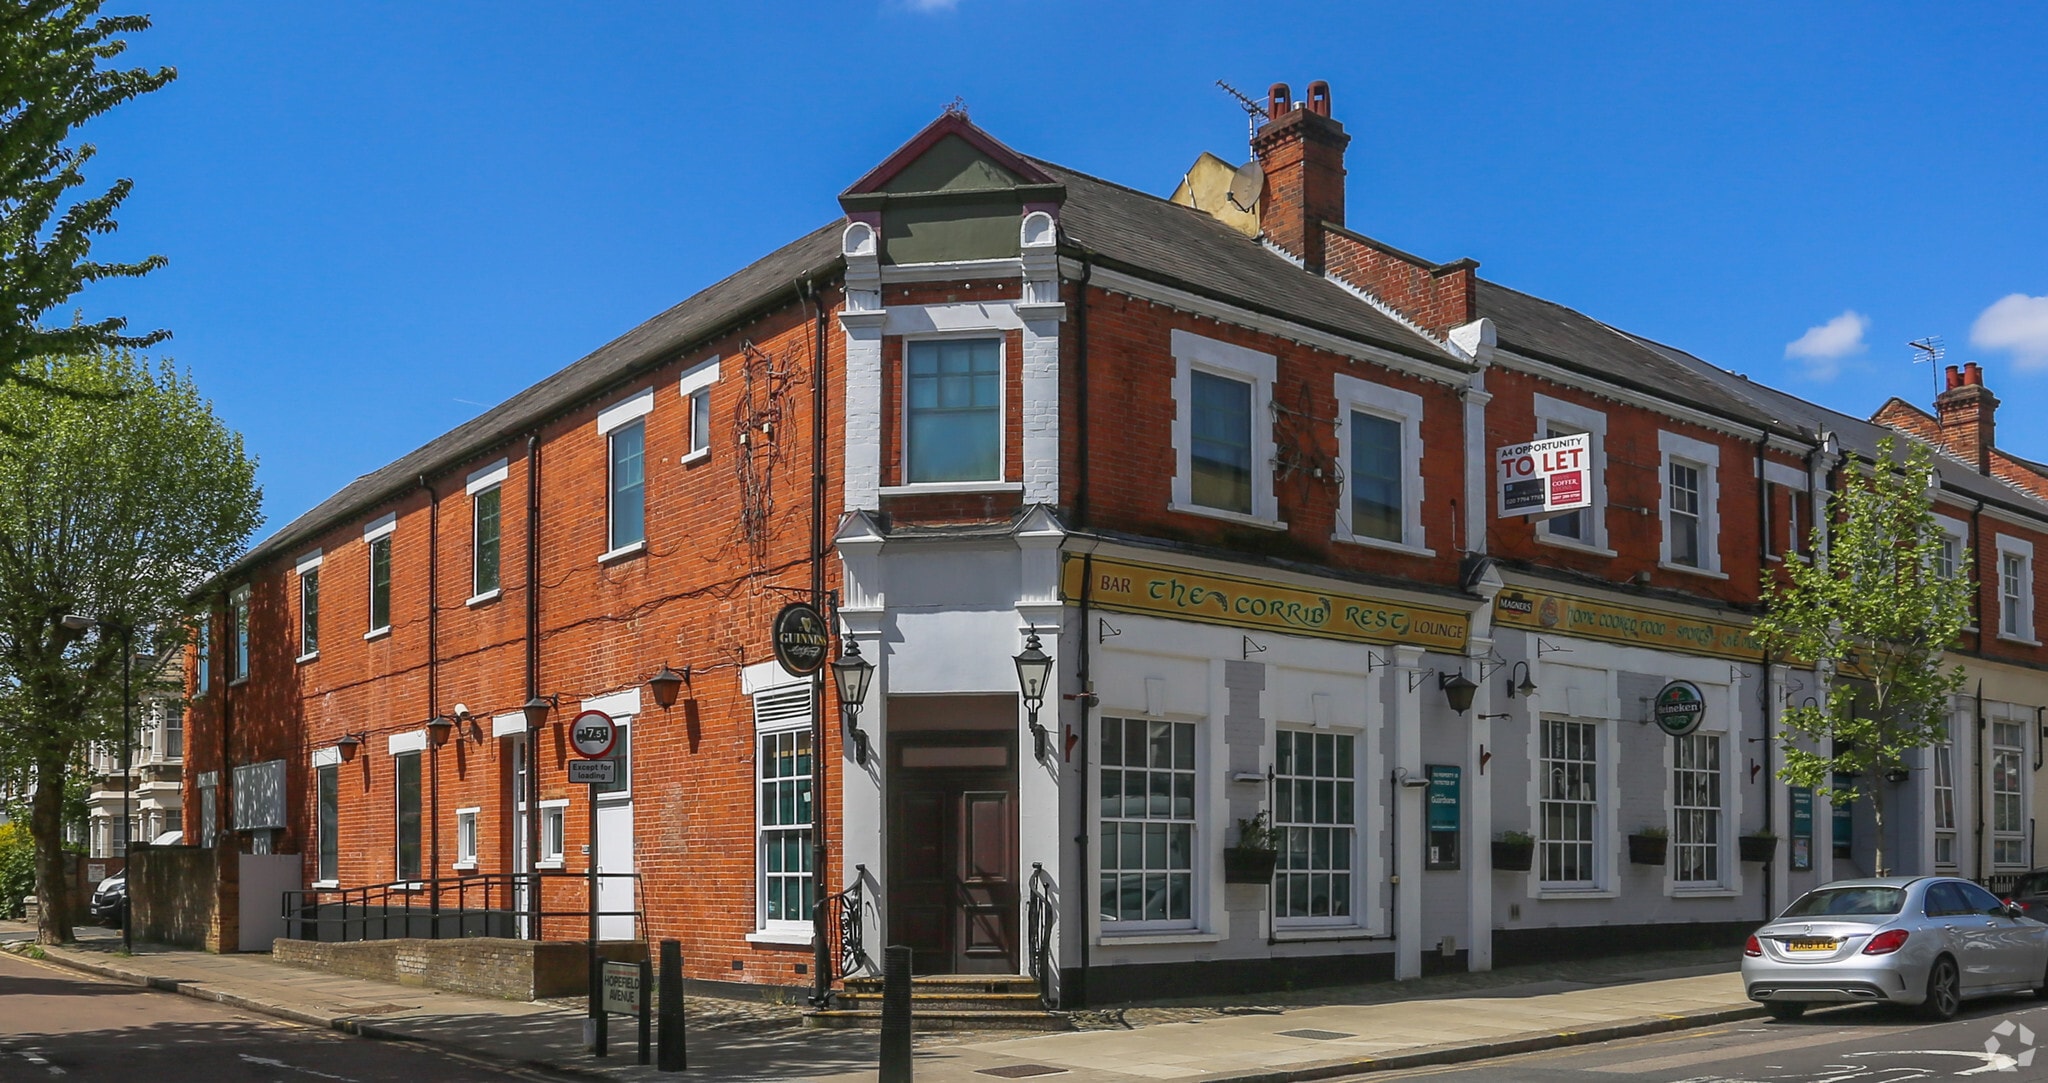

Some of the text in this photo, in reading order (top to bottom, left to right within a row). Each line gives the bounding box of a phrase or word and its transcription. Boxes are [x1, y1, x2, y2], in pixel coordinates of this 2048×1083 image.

[1501, 438, 1582, 457] A4 OPPORTUNITY
[1501, 447, 1583, 478] TO LET
[1101, 575, 1131, 593] BAR
[1234, 597, 1328, 628] CORRIB
[1414, 620, 1463, 638] LOUNGE
[1500, 598, 1532, 612] MAGNERS
[1640, 620, 1666, 636] FOOD
[779, 632, 827, 646] GUINNESS
[1659, 703, 1698, 714] Heineken
[572, 763, 612, 772] Except for
[577, 772, 606, 780] loading
[604, 975, 640, 989] HOPEFIELD
[609, 989, 635, 1003] AVENUE
